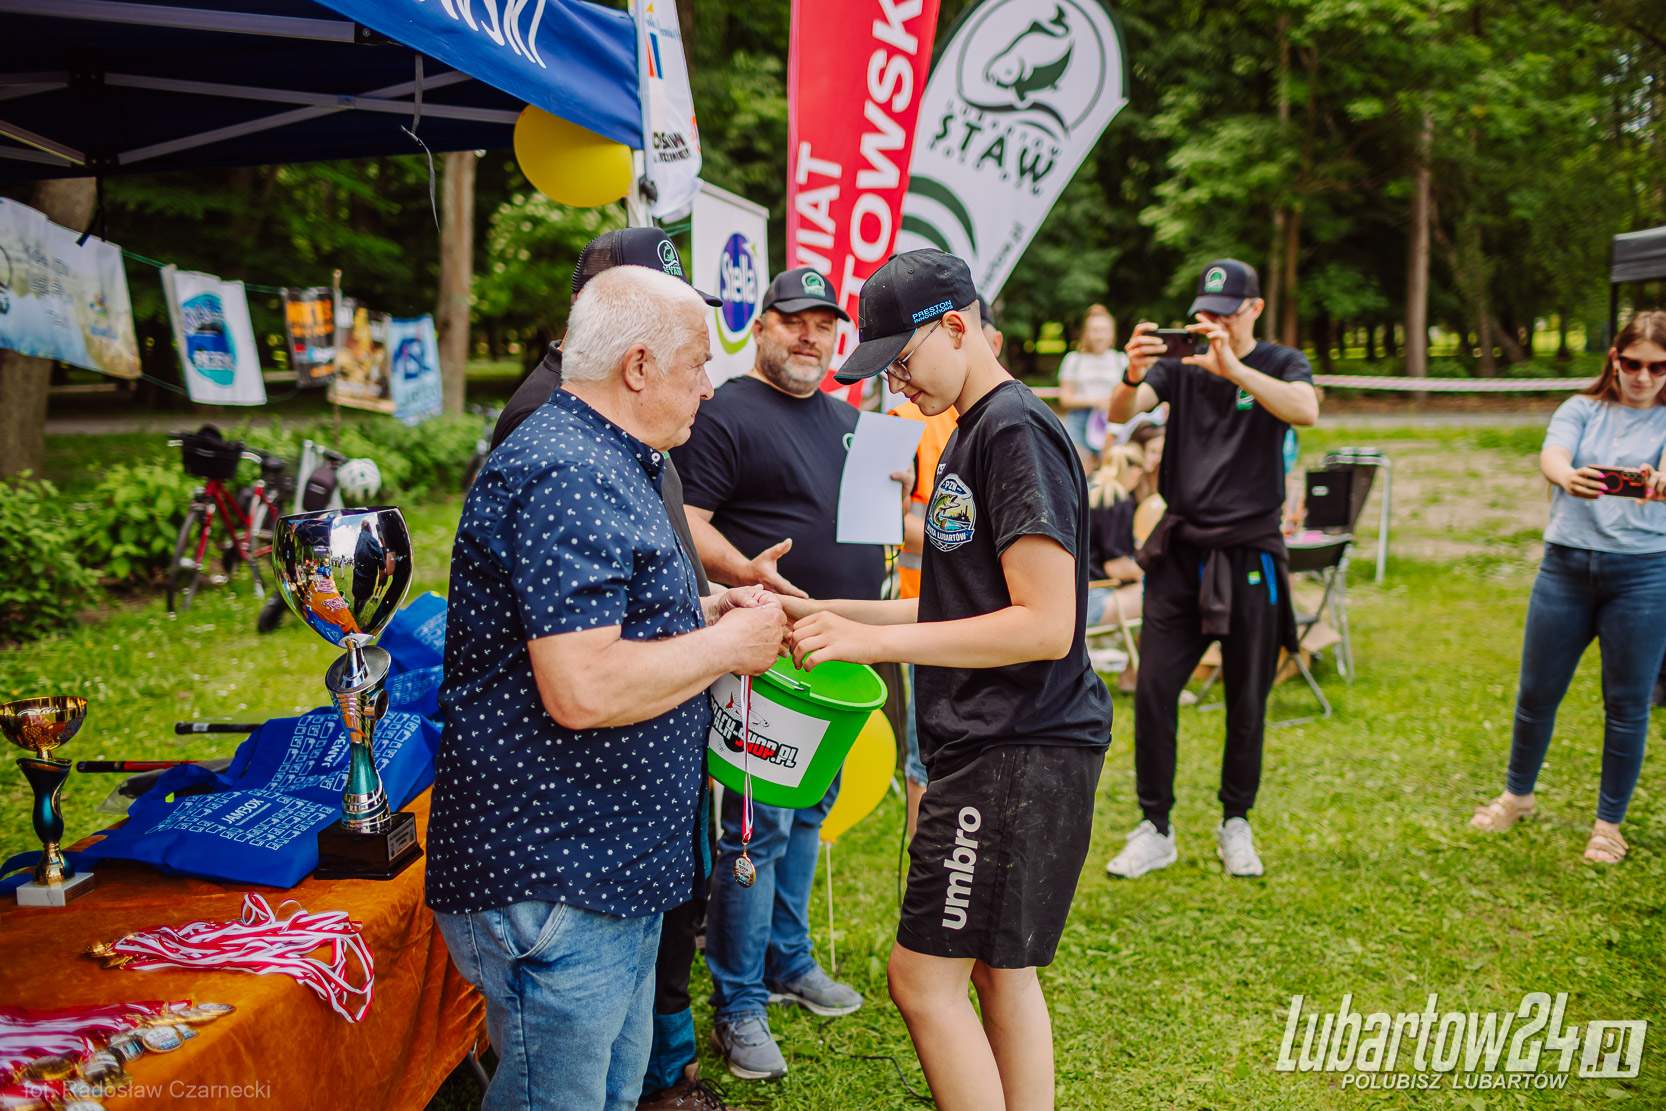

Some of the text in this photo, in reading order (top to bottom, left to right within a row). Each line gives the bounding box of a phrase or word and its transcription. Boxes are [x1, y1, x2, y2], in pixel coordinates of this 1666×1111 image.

[935, 114, 1054, 183] STAW
[912, 300, 952, 320] PRESTON
[942, 806, 982, 931] umbro
